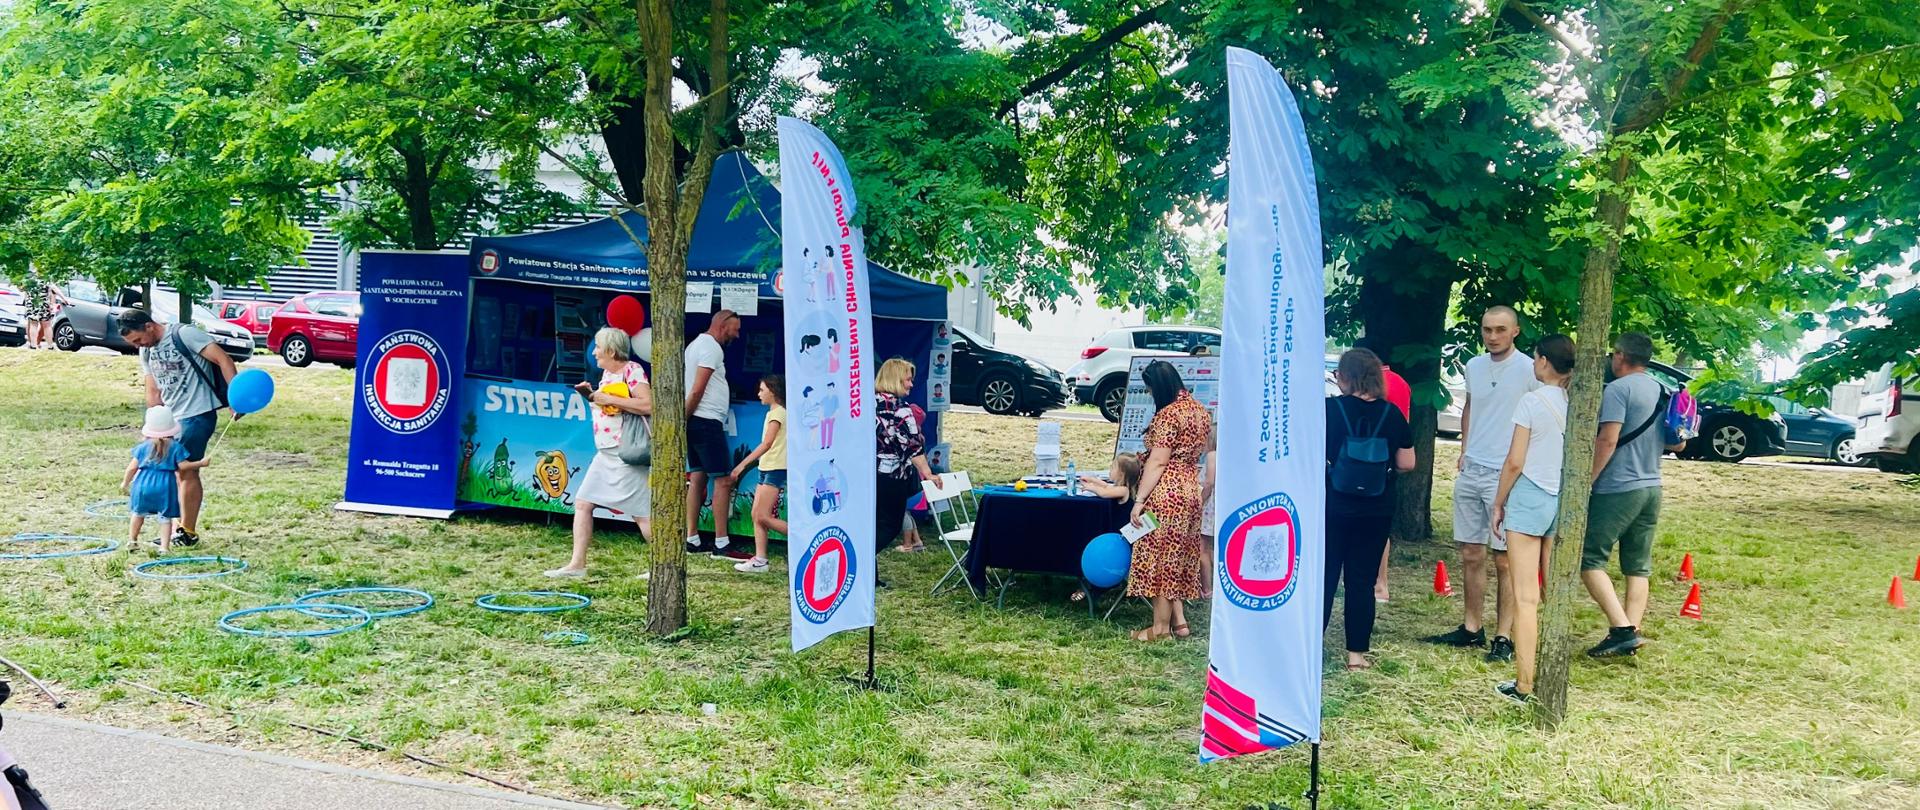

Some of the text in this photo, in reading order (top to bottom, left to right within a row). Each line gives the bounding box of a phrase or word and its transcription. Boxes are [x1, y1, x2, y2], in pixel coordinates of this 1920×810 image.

[508, 256, 552, 268] Powiatowa
[553, 261, 578, 271] Stacja
[709, 269, 767, 279] Sochaczewie
[363, 288, 463, 297] SANITARNO-EPIDEMIOLOGICZNA
[392, 297, 438, 305] SOCHACZEWIE
[379, 333, 438, 357] PAŃSTWOWA
[365, 384, 448, 431] INSPEKCJA SANITARNA
[484, 385, 586, 421] STREFA
